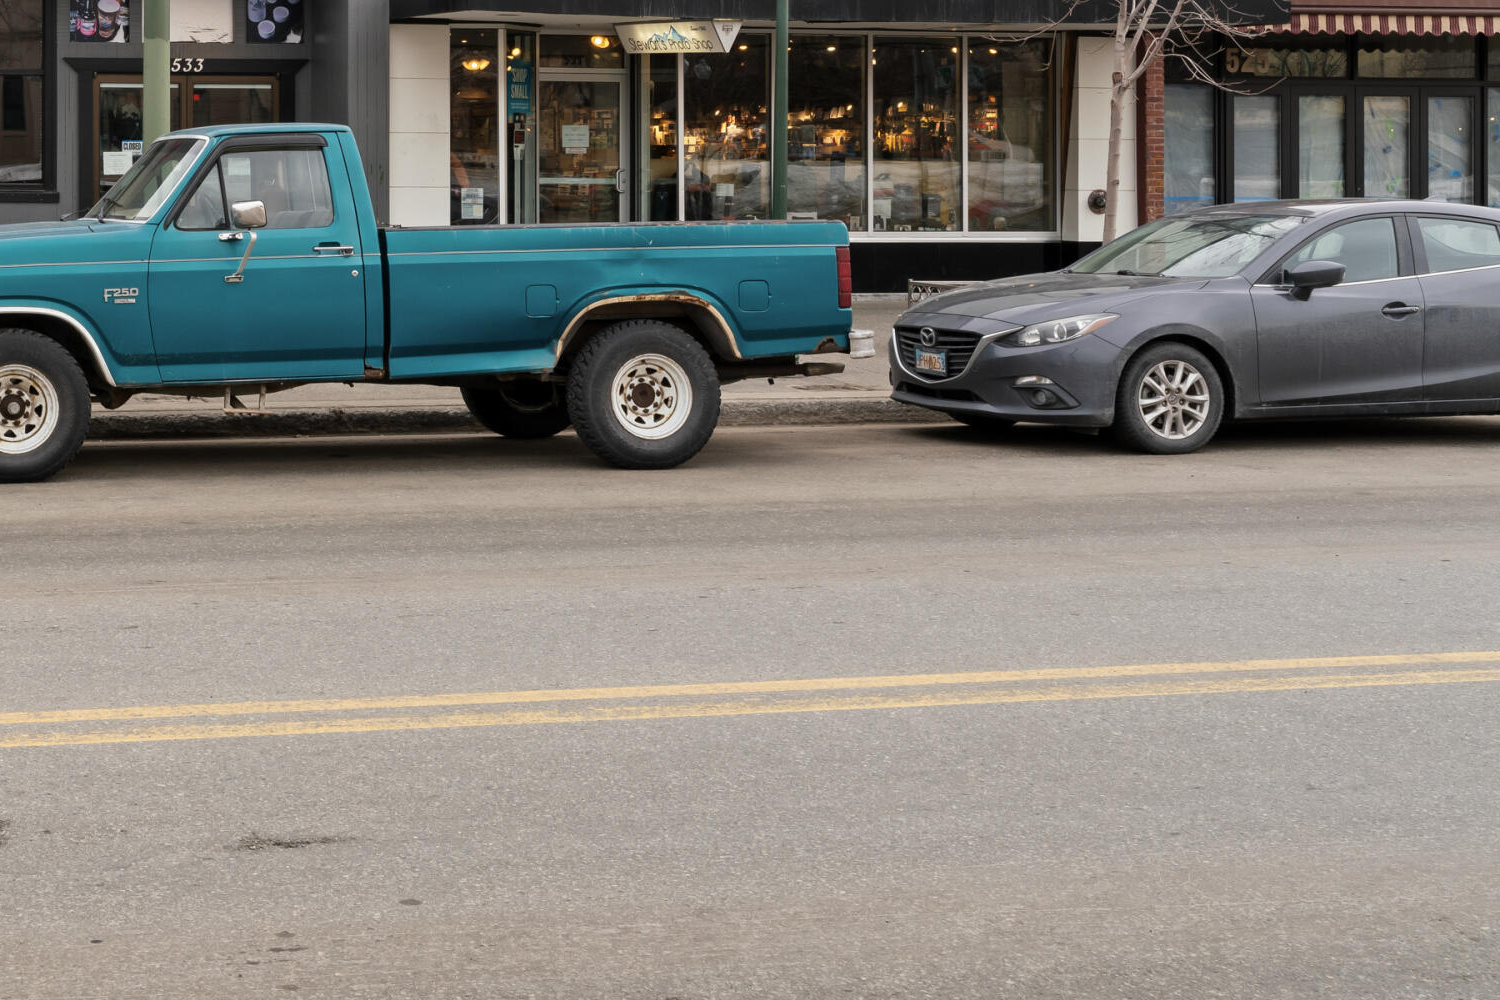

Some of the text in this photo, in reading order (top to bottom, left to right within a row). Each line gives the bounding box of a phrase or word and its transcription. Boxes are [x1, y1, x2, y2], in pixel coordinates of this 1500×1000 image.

[669, 38, 691, 50] Photo
[692, 37, 713, 52] Shop
[171, 58, 205, 73] 533
[512, 68, 528, 82] SHOP
[511, 84, 528, 99] SMALL
[123, 142, 142, 150] CLOSED
